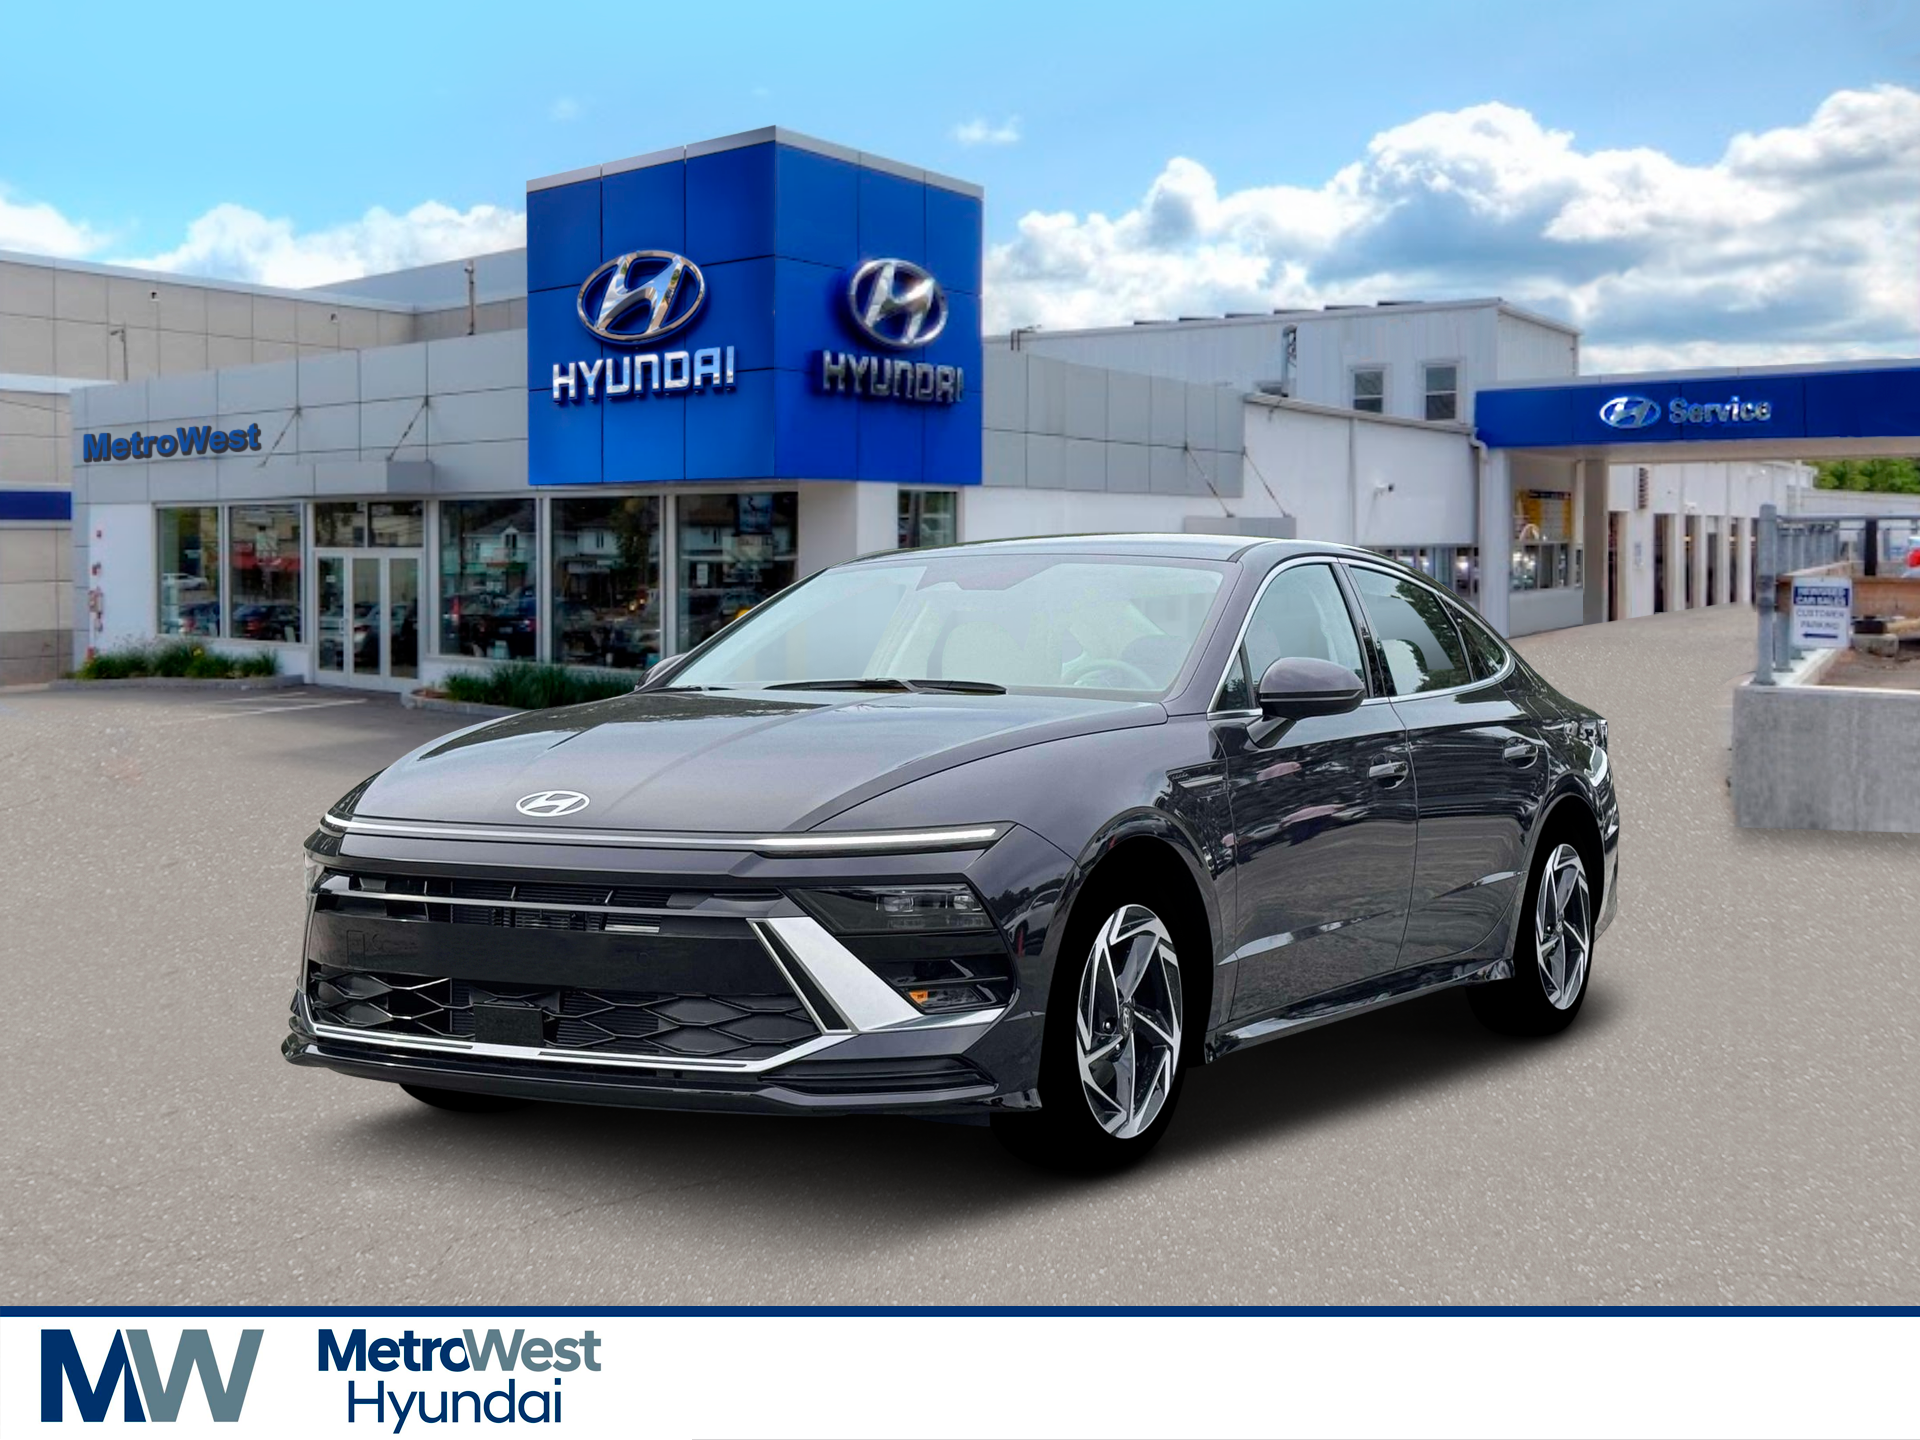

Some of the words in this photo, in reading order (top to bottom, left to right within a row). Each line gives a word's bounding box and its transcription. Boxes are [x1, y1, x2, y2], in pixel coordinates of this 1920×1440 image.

[553, 346, 735, 402] HYUNDAI
[823, 350, 965, 403] HYUNDAI
[1669, 396, 1771, 423] Service
[83, 423, 261, 461] MetroWest
[1796, 608, 1845, 618] CUSTOMER
[1800, 620, 1840, 630] PARKING
